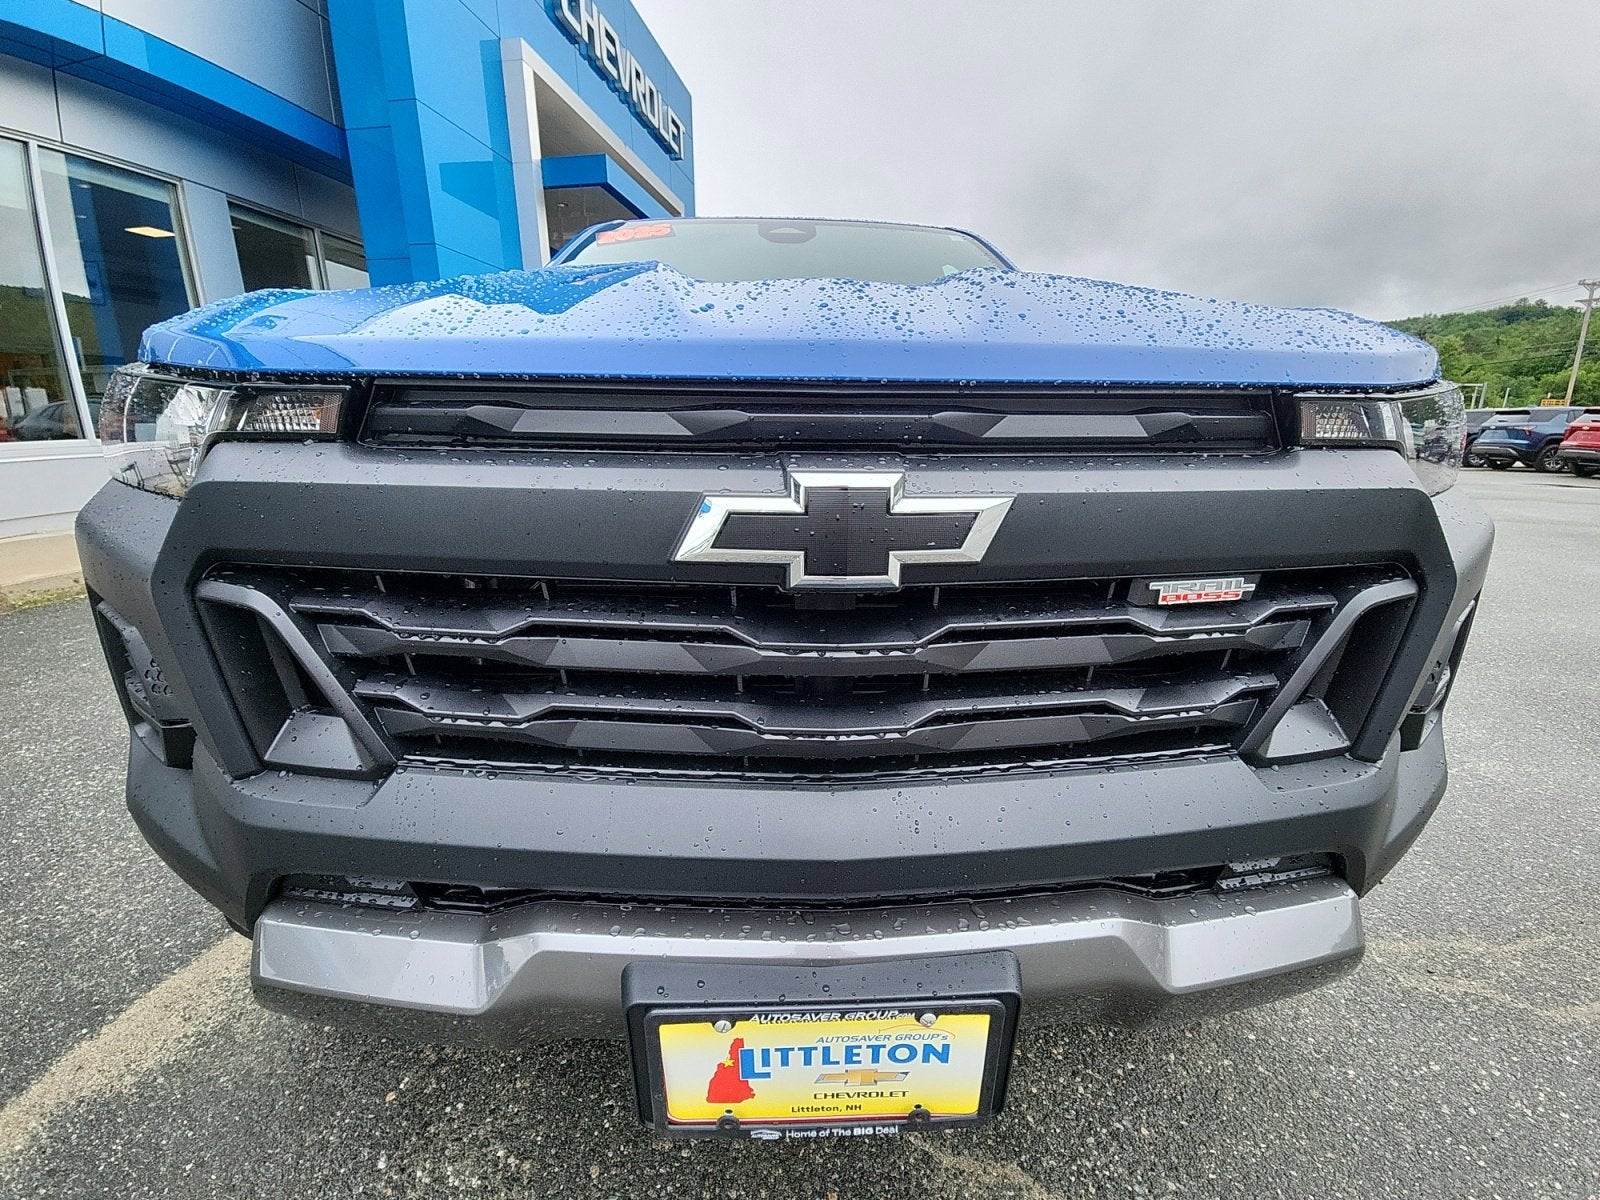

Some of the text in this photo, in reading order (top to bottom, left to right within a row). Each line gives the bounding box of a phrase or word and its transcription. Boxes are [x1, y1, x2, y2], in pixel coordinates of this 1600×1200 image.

[557, 0, 686, 161] CHEVROLET
[1149, 577, 1256, 594] TRAIL
[1160, 590, 1242, 604] BOSS
[749, 1012, 842, 1024] AUTOSAVER
[816, 1034, 892, 1044] AUTOSAVER
[813, 1090, 909, 1100] CHEVROLET
[791, 1105, 842, 1113] Littleton,
[786, 1129, 817, 1139] Home
[818, 1129, 830, 1138] of
[831, 1128, 851, 1137] The
[853, 1127, 874, 1136] BIG
[875, 1125, 899, 1135] Deal
